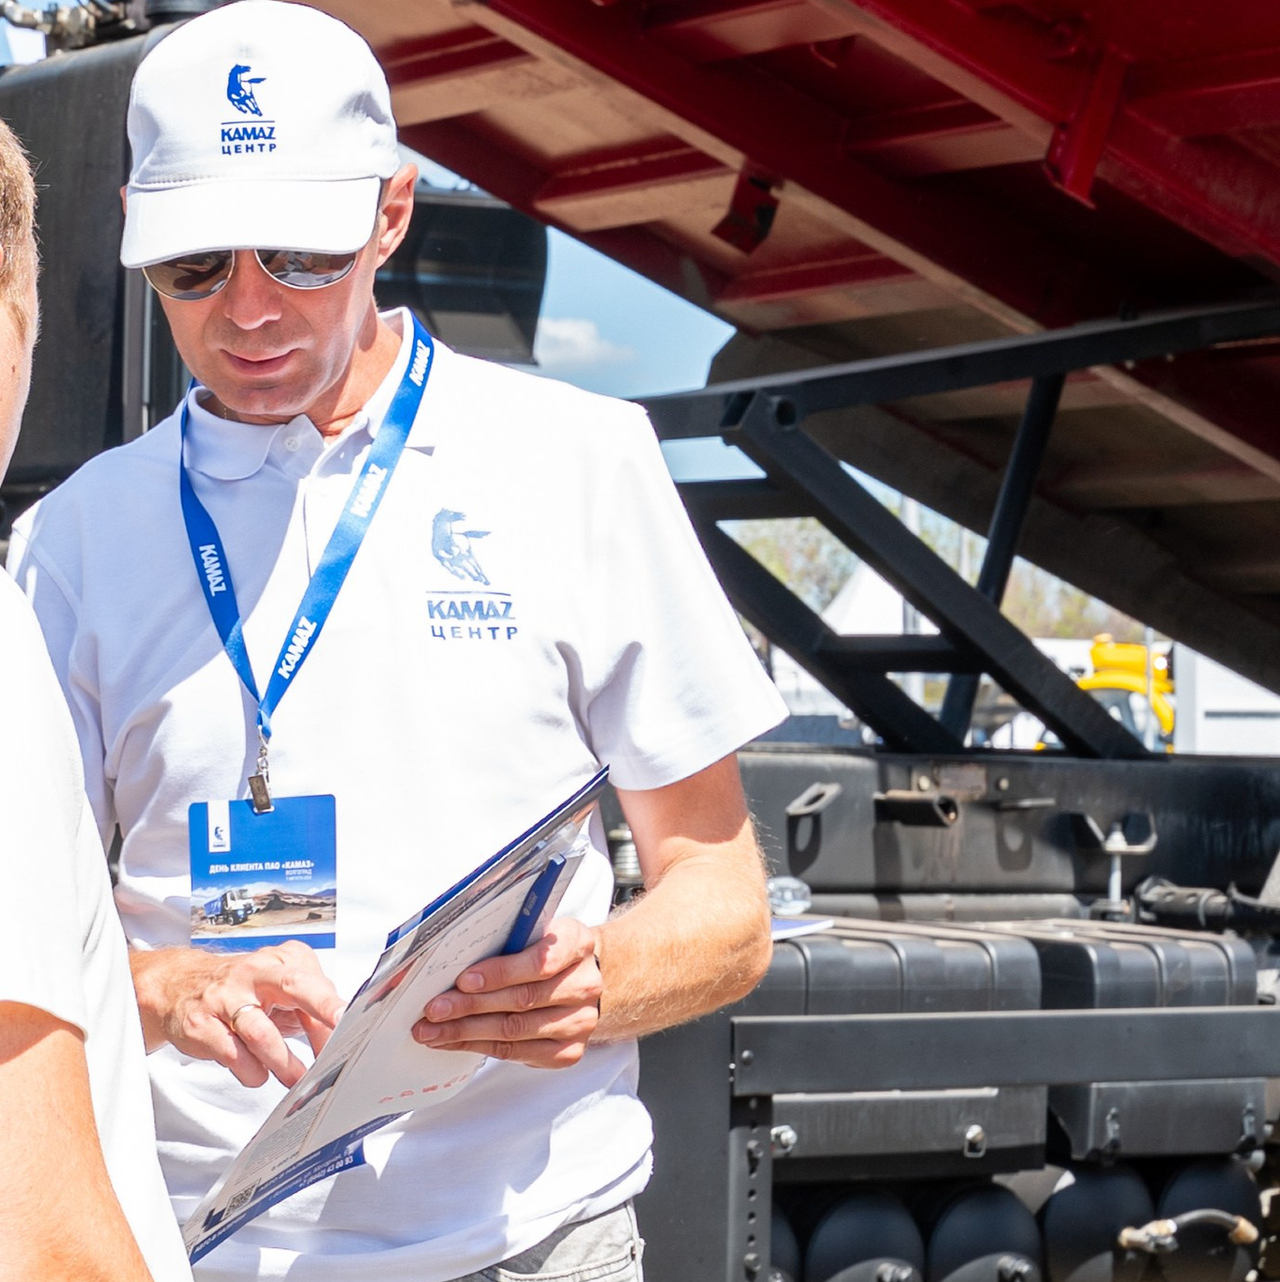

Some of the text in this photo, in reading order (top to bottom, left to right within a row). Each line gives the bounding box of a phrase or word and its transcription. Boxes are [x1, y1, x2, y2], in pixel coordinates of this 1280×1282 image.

[221, 127, 276, 142] KAMAZ
[222, 143, 277, 156] ЦЕНТР
[409, 339, 430, 387] KAMAZ
[349, 463, 388, 518] KAMAZ
[199, 544, 227, 597] KAMAZ
[427, 600, 516, 621] KAMAZ
[431, 625, 518, 640] ЦЕНТР
[278, 616, 317, 679] KAMAZ
[209, 864, 229, 874] ДЕНЬ
[264, 861, 280, 870] ПАО
